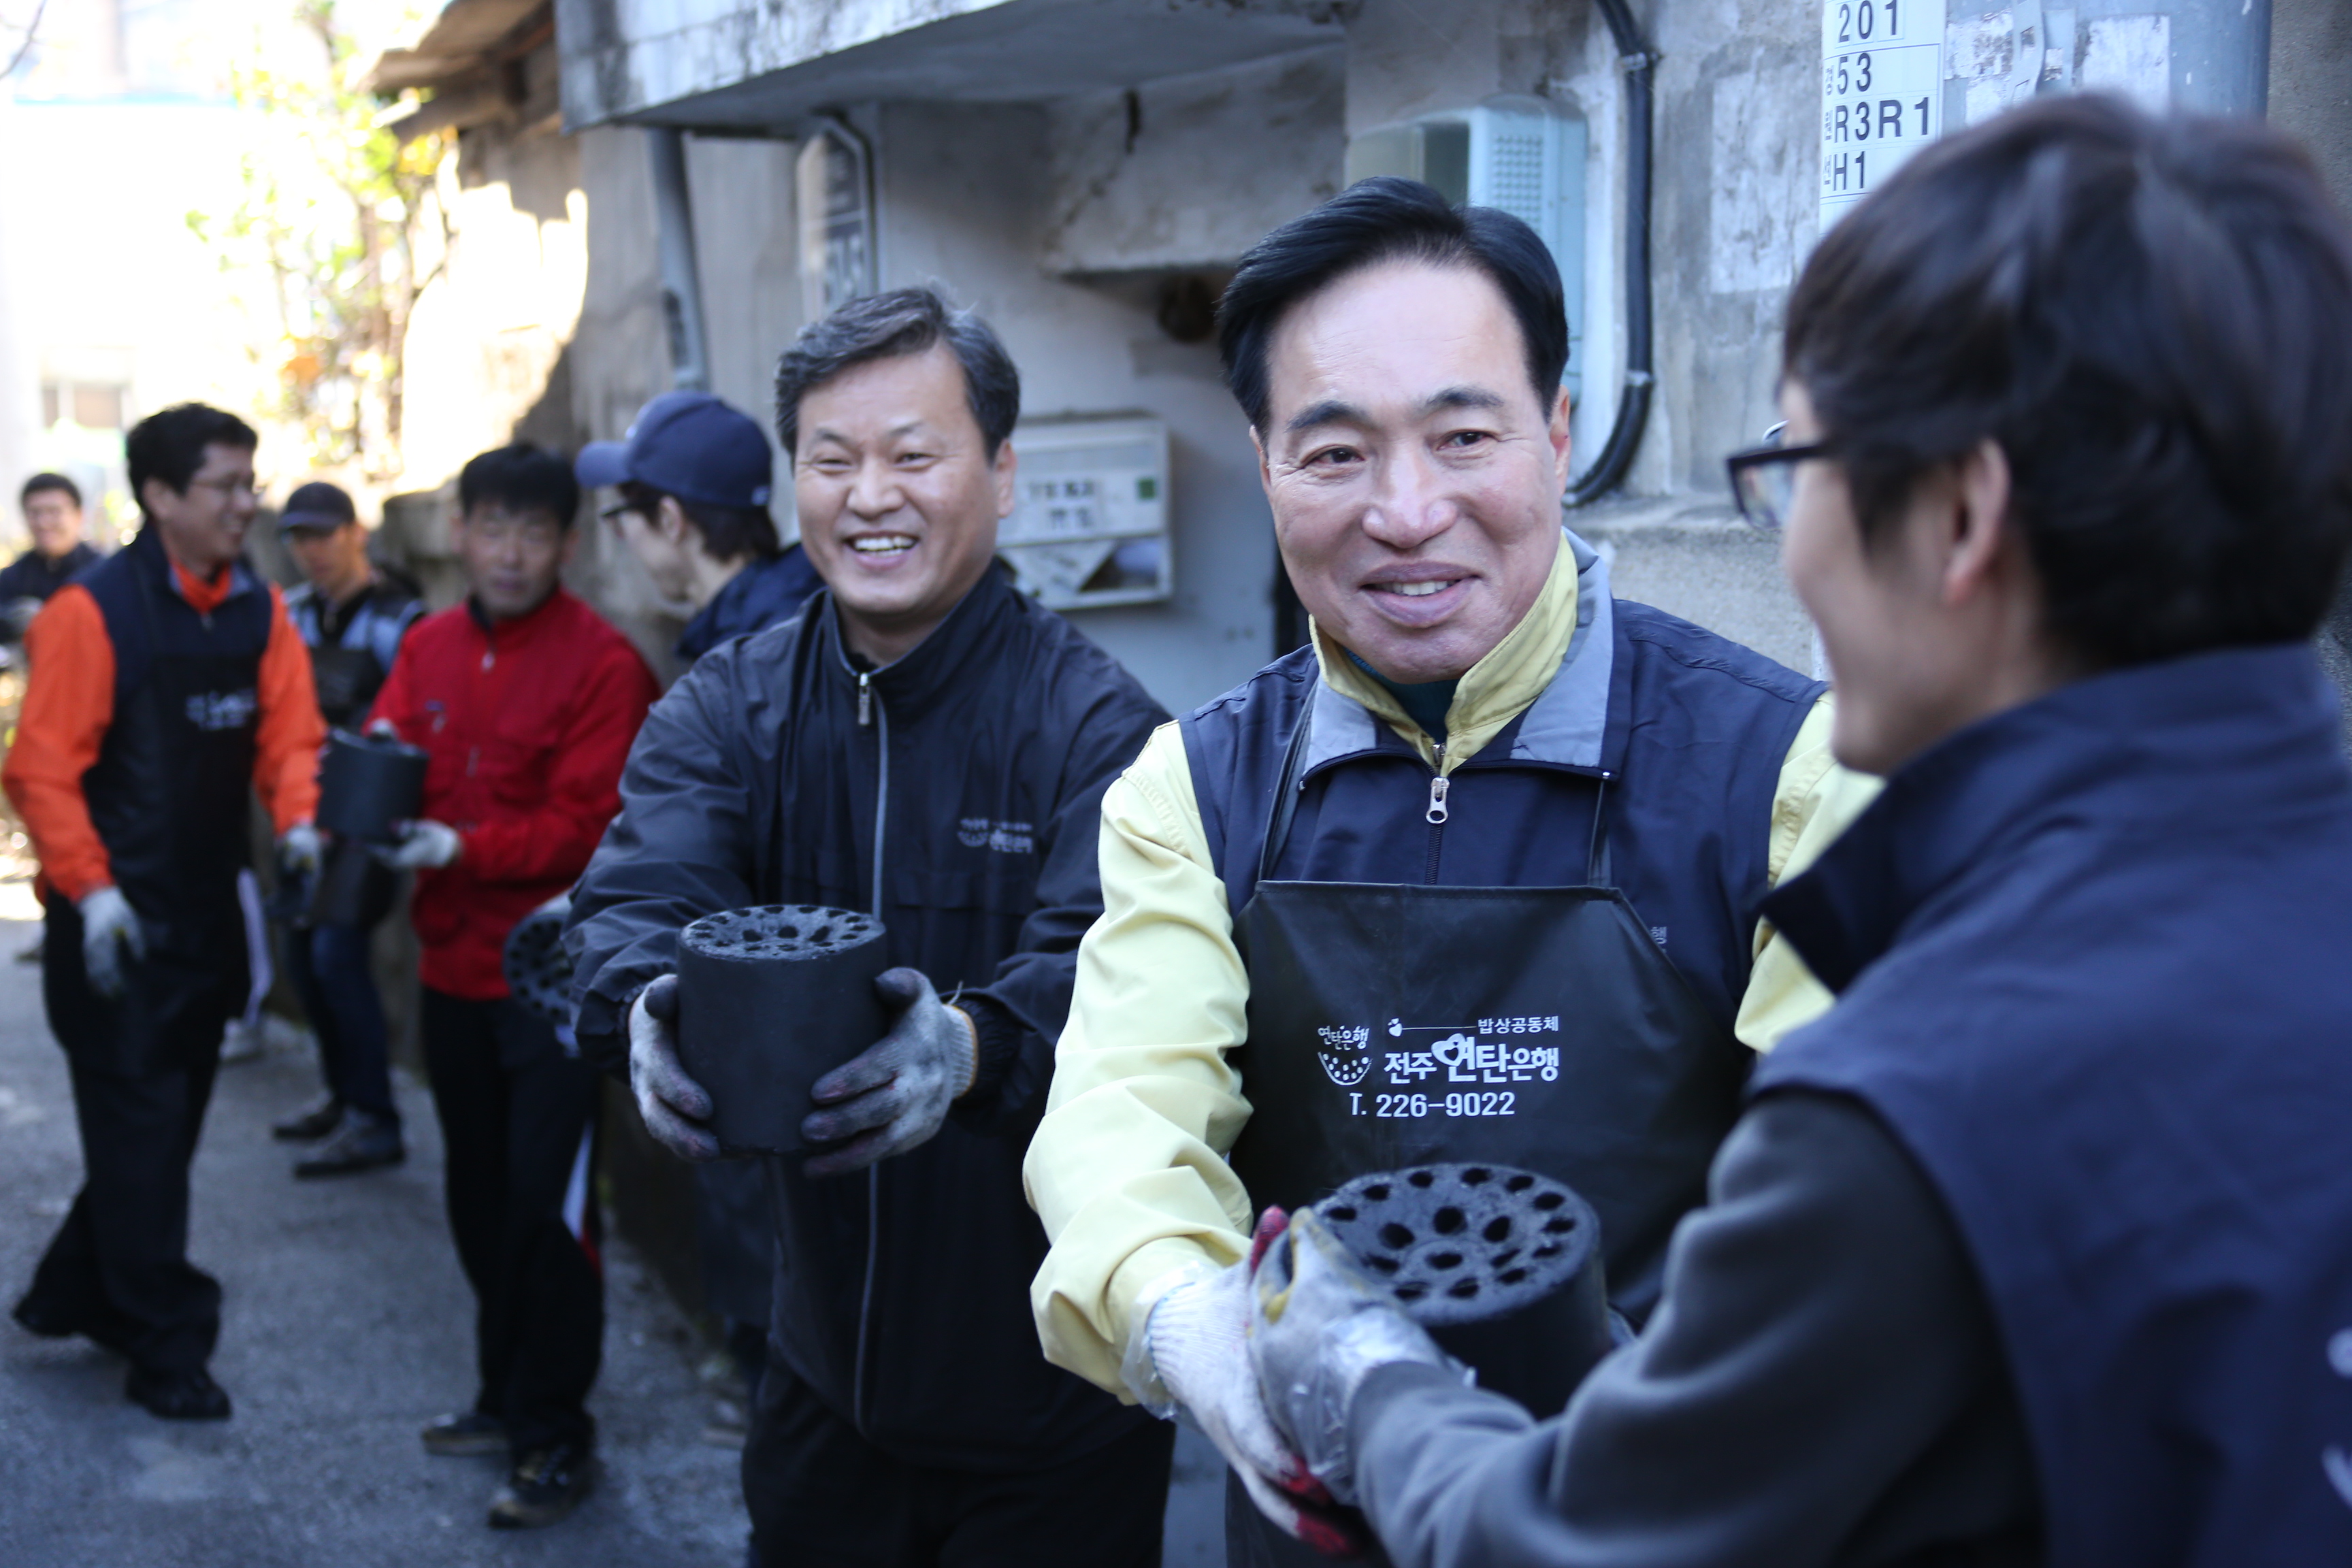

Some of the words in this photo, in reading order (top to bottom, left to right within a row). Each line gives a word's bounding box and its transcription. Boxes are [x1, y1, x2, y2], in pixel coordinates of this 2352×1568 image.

[1838, 0, 1897, 43] 201
[1837, 52, 1871, 95] 53
[1834, 97, 1929, 143] R3R1
[1833, 151, 1865, 191] H1
[1318, 1025, 1370, 1051] 연탄은행
[1477, 1016, 1559, 1034] 밥상공동체
[1350, 1092, 1367, 1115] T.
[1375, 1092, 1516, 1117] 226-9022
